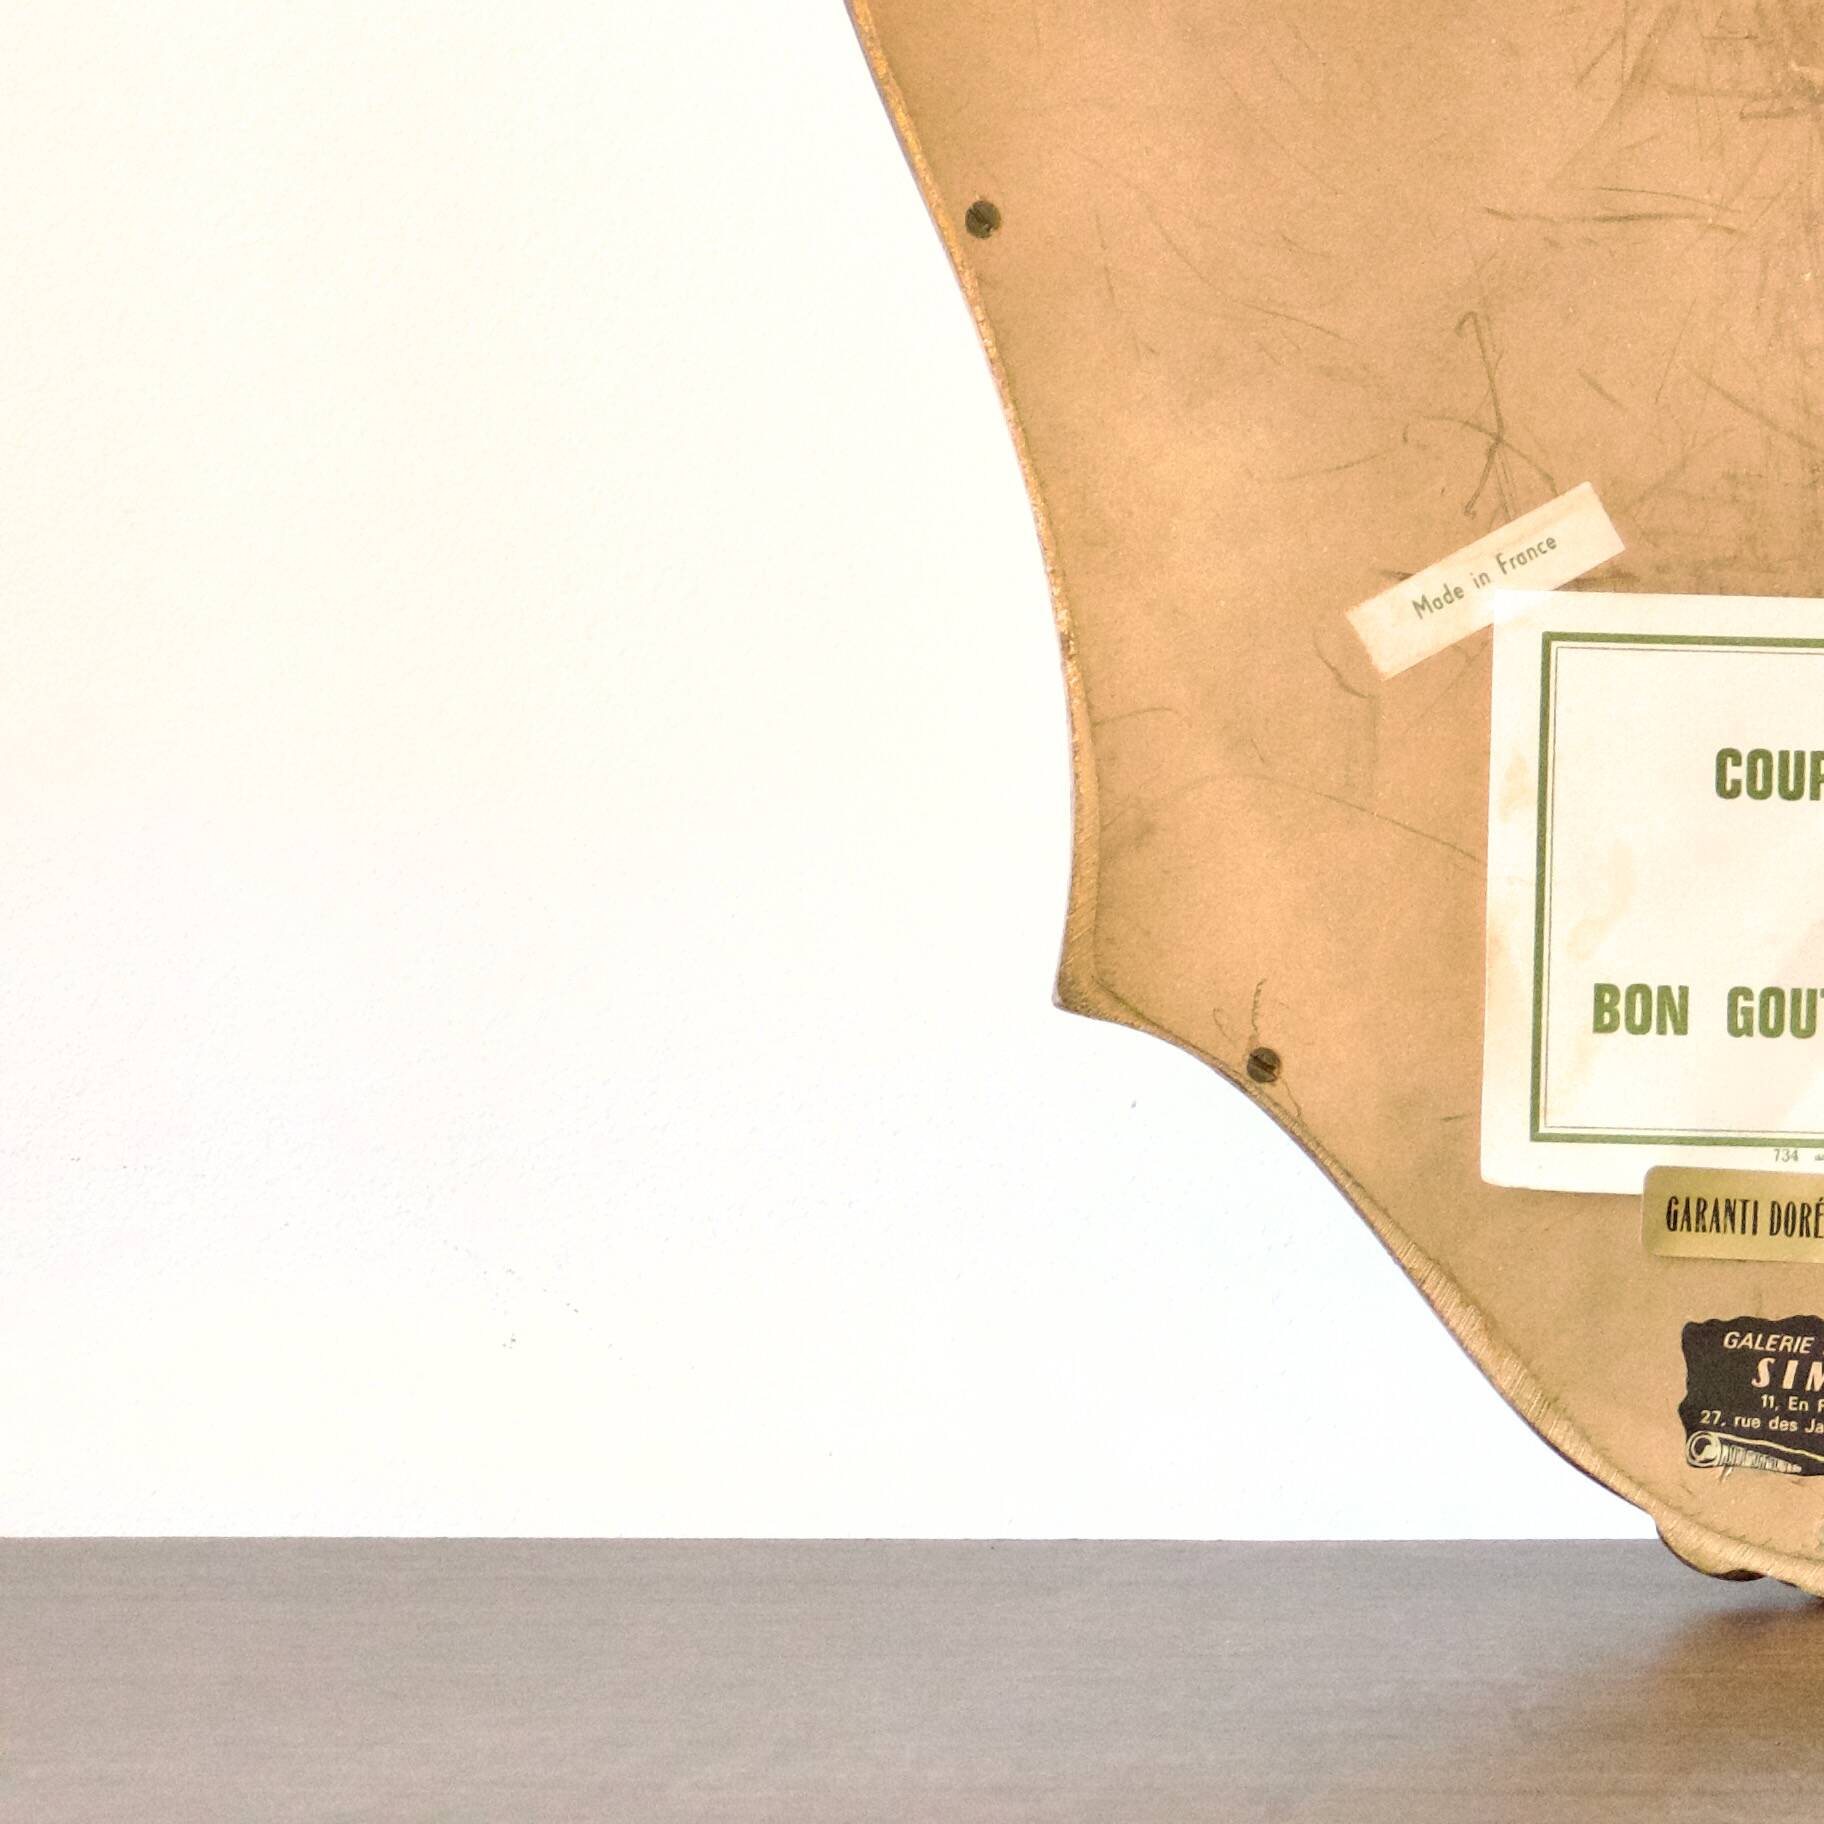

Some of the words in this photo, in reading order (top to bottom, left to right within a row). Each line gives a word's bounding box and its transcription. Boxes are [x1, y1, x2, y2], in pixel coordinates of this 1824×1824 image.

[1411, 584, 1465, 620] Made
[1470, 572, 1491, 589] in
[1496, 535, 1558, 575] France
[1592, 984, 1690, 1038] BON
[1665, 1196, 1760, 1236] GARANTI
[1723, 1332, 1815, 1354] GALERIE
[1760, 1394, 1780, 1410] 11,
[1788, 1396, 1809, 1412] En
[1734, 1416, 1761, 1430] rue
[1768, 1415, 1798, 1433] des
